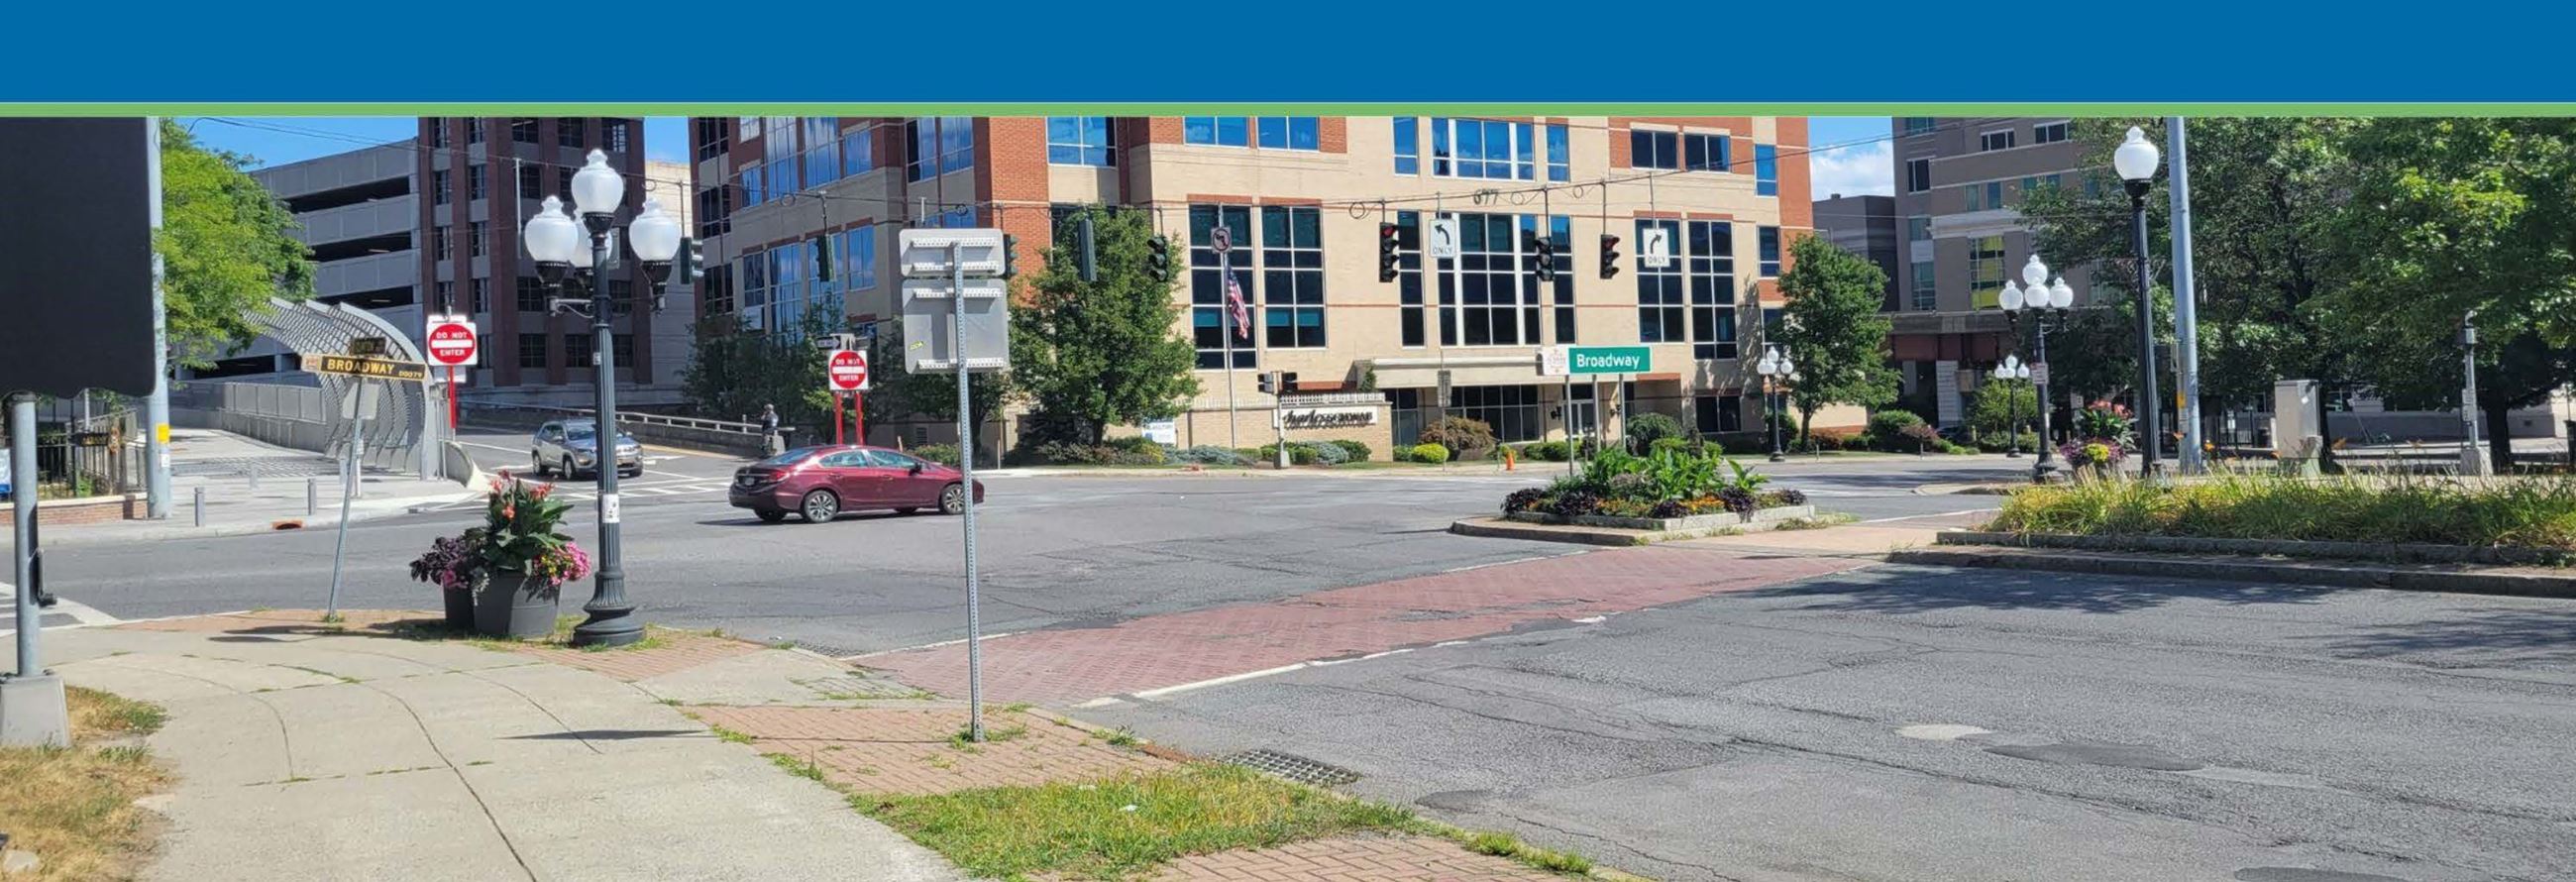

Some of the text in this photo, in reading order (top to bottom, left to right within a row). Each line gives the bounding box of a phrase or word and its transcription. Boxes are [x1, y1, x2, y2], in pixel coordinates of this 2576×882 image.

[1433, 246, 1452, 255] ONLY
[326, 358, 394, 375] BROADWAY
[1576, 352, 1640, 370] Broadway
